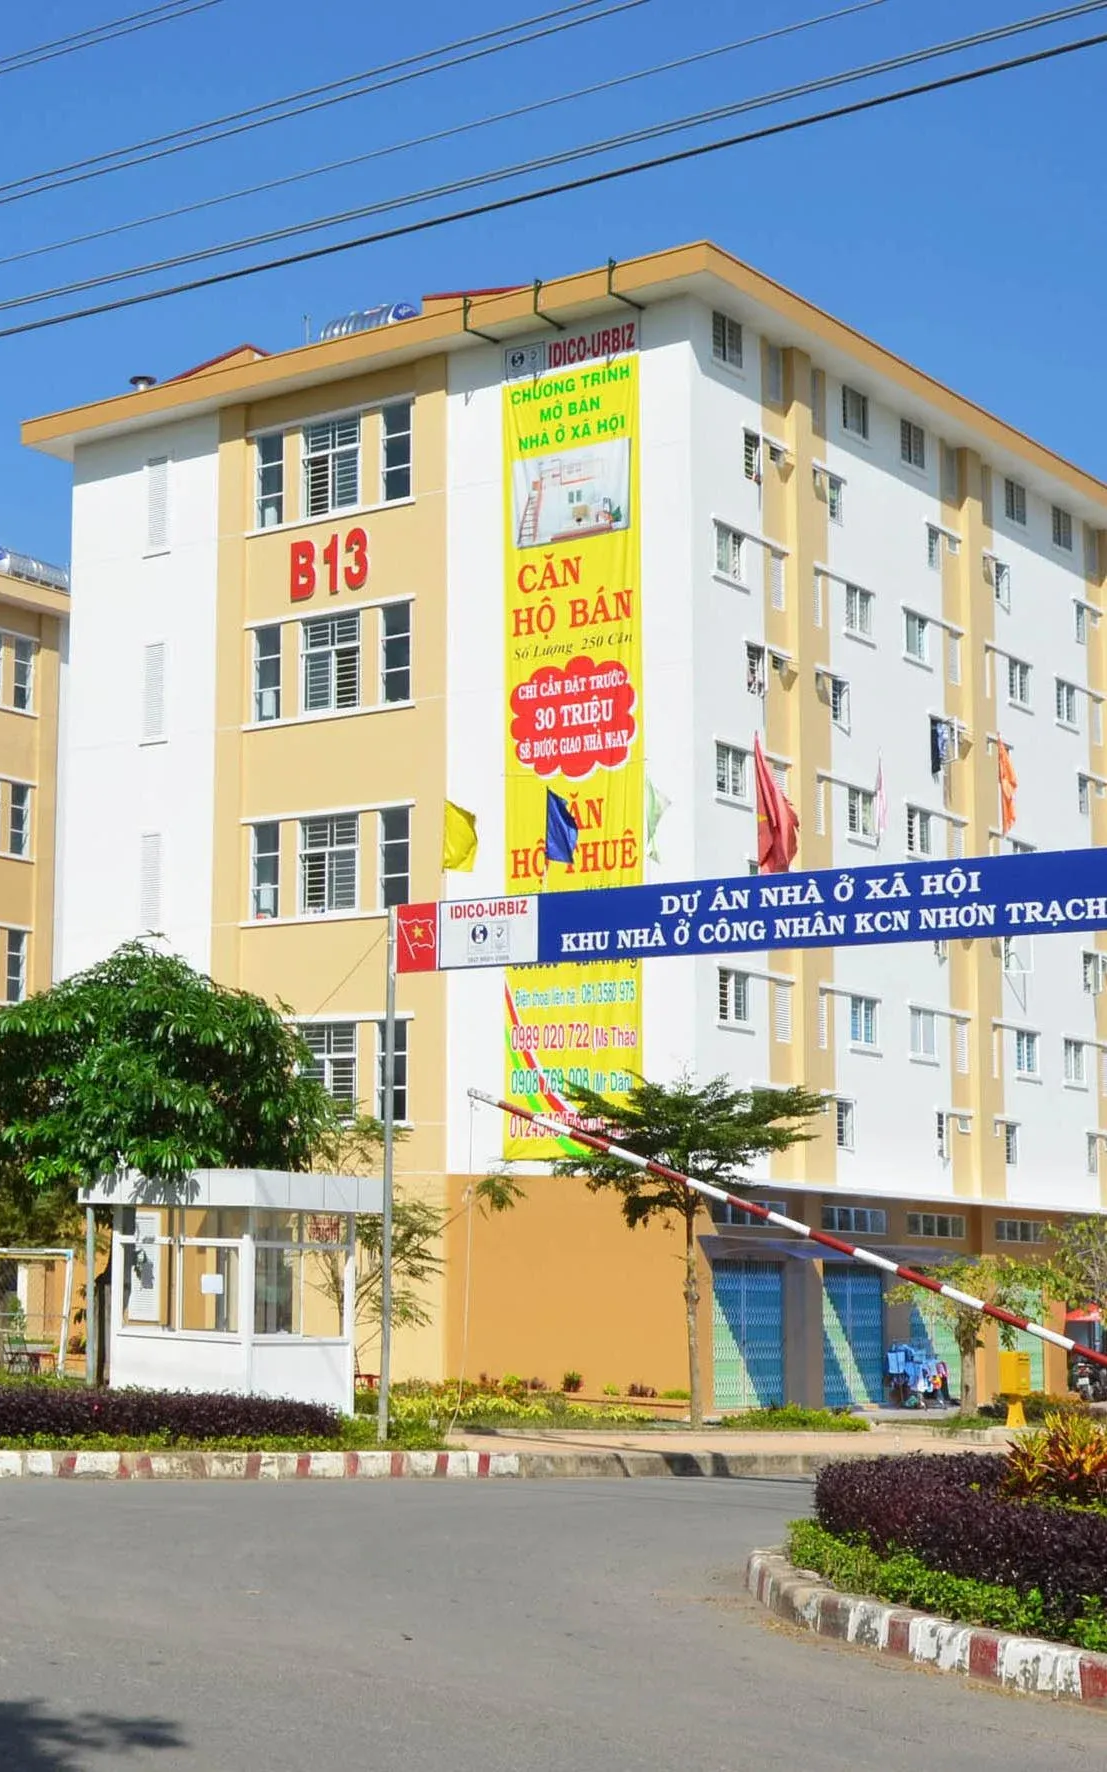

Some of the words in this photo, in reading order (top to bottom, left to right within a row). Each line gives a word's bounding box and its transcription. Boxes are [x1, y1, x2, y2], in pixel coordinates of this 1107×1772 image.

[581, 363, 630, 386] TRÌNH
[540, 399, 563, 423] MỞ
[568, 396, 600, 416] BÁN
[518, 430, 550, 452] NHÀ
[555, 422, 566, 443] Ở
[571, 421, 591, 440] XÃ
[597, 413, 625, 436] HỘI
[290, 527, 368, 604] B13
[517, 553, 582, 594] CĂN
[512, 596, 556, 640] HỘ
[569, 586, 633, 629] BÁN
[581, 634, 604, 650] 250
[518, 680, 538, 701] CHỈ
[564, 674, 587, 697] ĐẶT
[590, 668, 625, 692] TRƯỚC
[535, 707, 556, 731] 30
[560, 695, 614, 728] TRIỆU
[533, 738, 558, 761] ĐƯỢC
[560, 736, 581, 754] GIAO
[583, 729, 603, 753] NHÀ
[605, 729, 629, 750] NGAY
[568, 791, 604, 831] ĂN
[511, 838, 549, 884] HỘ
[660, 889, 702, 917] DỰ
[709, 885, 750, 912] ÁN
[759, 878, 824, 908] NHÀ
[833, 873, 855, 902] Ở
[865, 872, 911, 900] XÃ
[920, 867, 982, 899] HỘI
[560, 930, 610, 953] KHU
[616, 922, 667, 950] NHÀ
[674, 918, 691, 945] Ở
[698, 918, 767, 944] CÔNG
[773, 911, 847, 939] NHÂN
[854, 908, 911, 934] KCN
[918, 902, 997, 930] NHƠN
[1004, 897, 1107, 927] TRẠCH
[511, 1024, 540, 1051] 0989
[543, 1023, 565, 1049] 020
[568, 1022, 589, 1048] 722
[511, 1069, 538, 1094] 0908
[543, 1068, 564, 1093] 769
